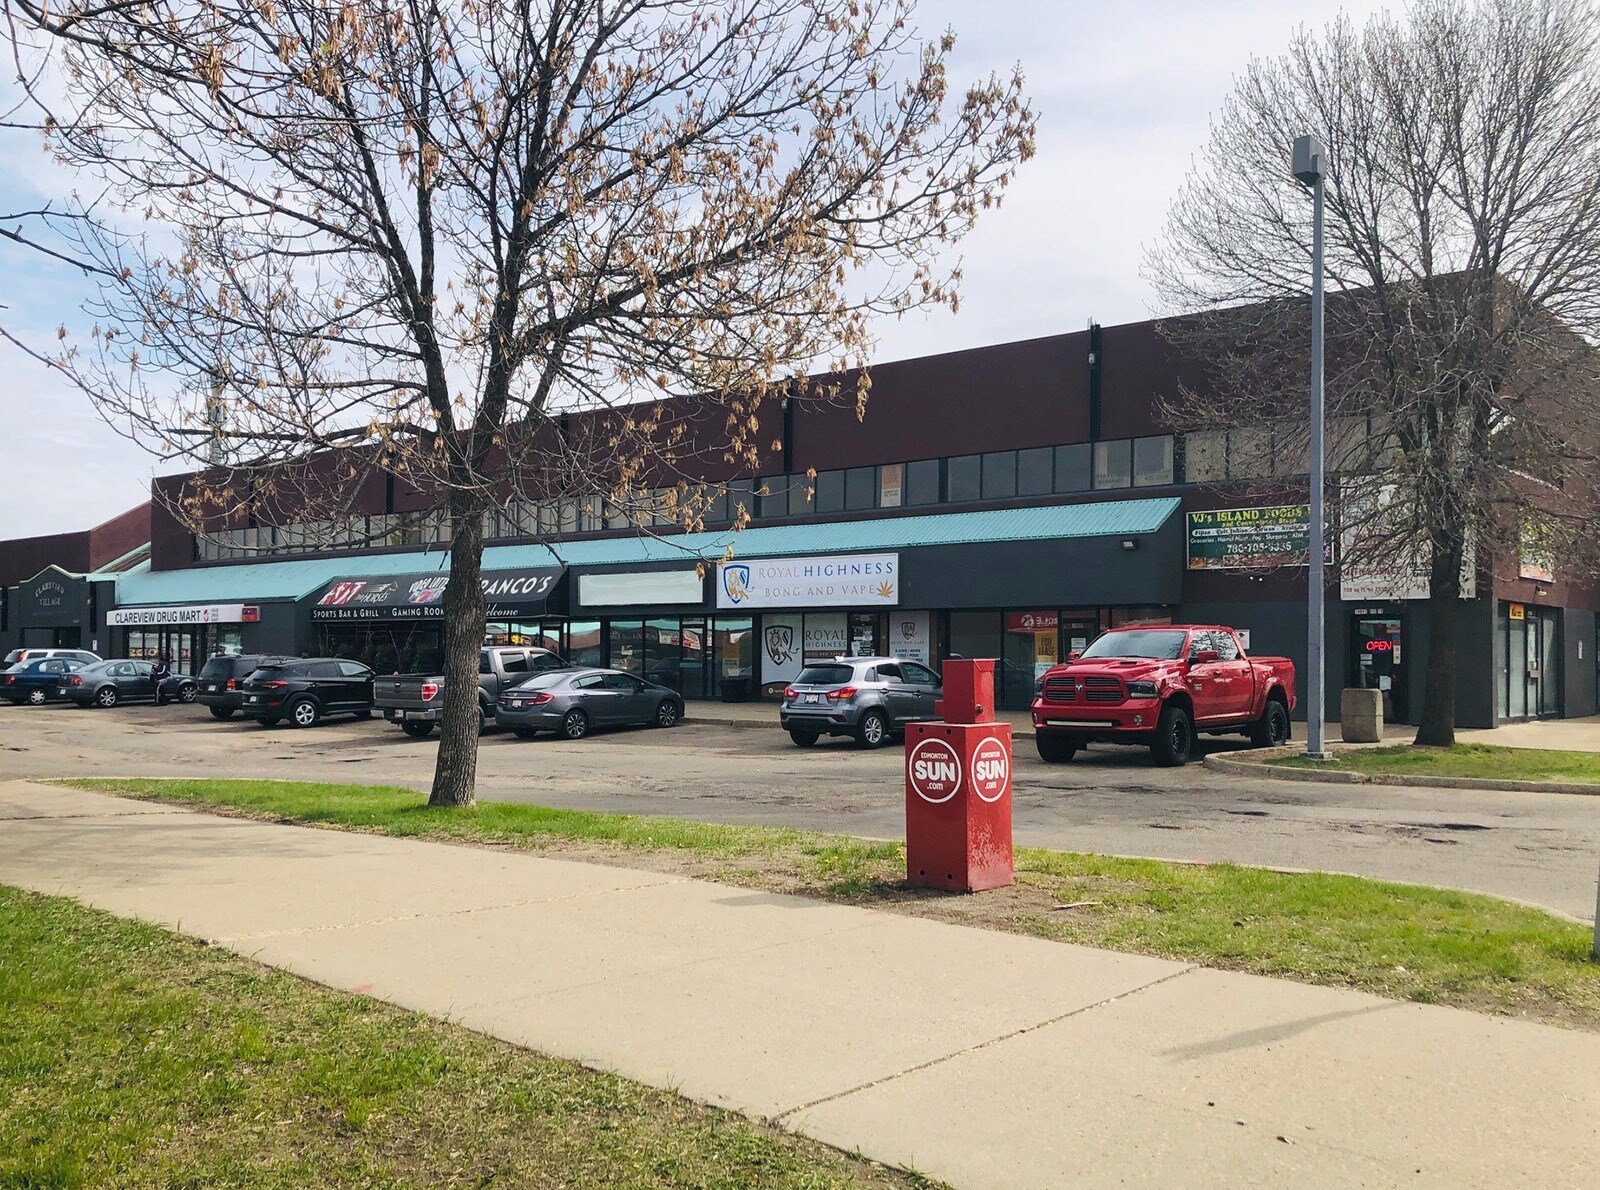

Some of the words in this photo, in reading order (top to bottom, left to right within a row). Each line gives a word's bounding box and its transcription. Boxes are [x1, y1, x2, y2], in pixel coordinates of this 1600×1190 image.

[1216, 510, 1260, 522] ISLAND
[759, 566, 799, 579] ROYAL
[804, 561, 893, 577] HIGHNESS
[480, 576, 553, 595] RANCO'S
[765, 586, 800, 597] BONG
[807, 585, 834, 596] AND
[841, 584, 875, 595] VAPE
[313, 609, 337, 618] SPORTS
[338, 609, 351, 618] BAR
[353, 610, 358, 618] &
[360, 608, 379, 617] GRILL
[391, 607, 421, 616] GAMING
[485, 603, 518, 616] elcome
[115, 611, 155, 623] CLAREVIEW
[157, 610, 177, 623] DRUG
[179, 610, 201, 622] MART
[805, 629, 847, 641] ROYAL
[1366, 641, 1392, 651] OPEN
[920, 752, 948, 760] EDMONTON
[915, 759, 956, 782] SUN
[976, 759, 1005, 780] SUN
[926, 781, 944, 791] .com
[984, 780, 997, 790] .com
